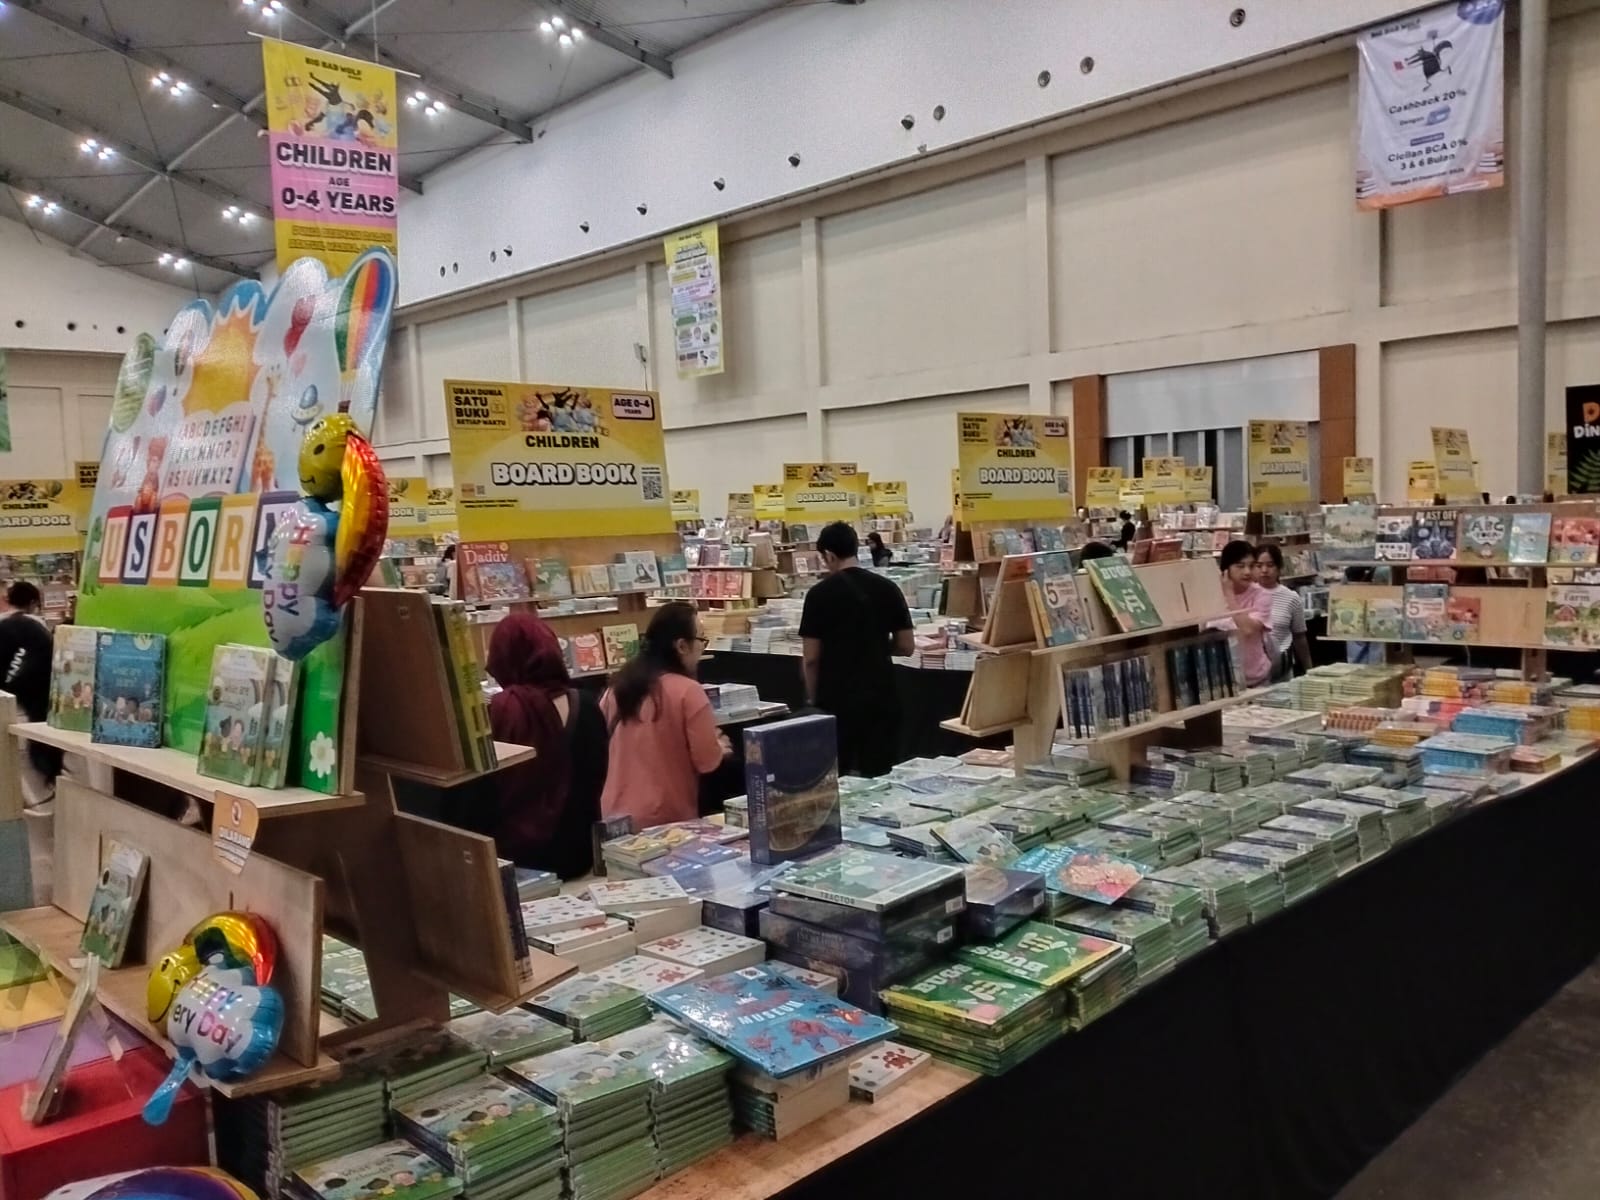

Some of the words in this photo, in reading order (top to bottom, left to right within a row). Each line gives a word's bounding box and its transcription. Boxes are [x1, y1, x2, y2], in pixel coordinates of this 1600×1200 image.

[321, 61, 339, 71] BAD
[1388, 95, 1440, 115] Cashback
[276, 141, 393, 173] CHILDREN
[1387, 149, 1423, 162] Cicilan
[1425, 142, 1448, 155] BCA
[1401, 162, 1407, 171] 3
[1418, 158, 1425, 167] 6
[1427, 153, 1456, 166] Bulan
[328, 176, 350, 187] AGE
[281, 187, 321, 207] 0-4
[326, 192, 396, 213] YEARS
[454, 396, 488, 407] SATU
[614, 398, 633, 408] AGE
[633, 399, 650, 408] 0-4
[455, 407, 490, 418] BUKU
[1582, 401, 1600, 423] D
[526, 435, 600, 450] CHILDREN
[996, 448, 1037, 458] CHILDREN
[490, 462, 575, 487] BOARD
[575, 463, 637, 486] BOOK
[979, 467, 1023, 485] BOARD
[1022, 467, 1056, 484] BOOK
[0, 516, 32, 528] ARD
[31, 514, 72, 527] BOOK
[1471, 519, 1504, 532] ABC
[463, 549, 509, 565] Daddy
[1044, 581, 1059, 606] 5
[1408, 601, 1420, 616] 5
[911, 963, 974, 994] BUGS
[197, 1010, 243, 1054] Day
